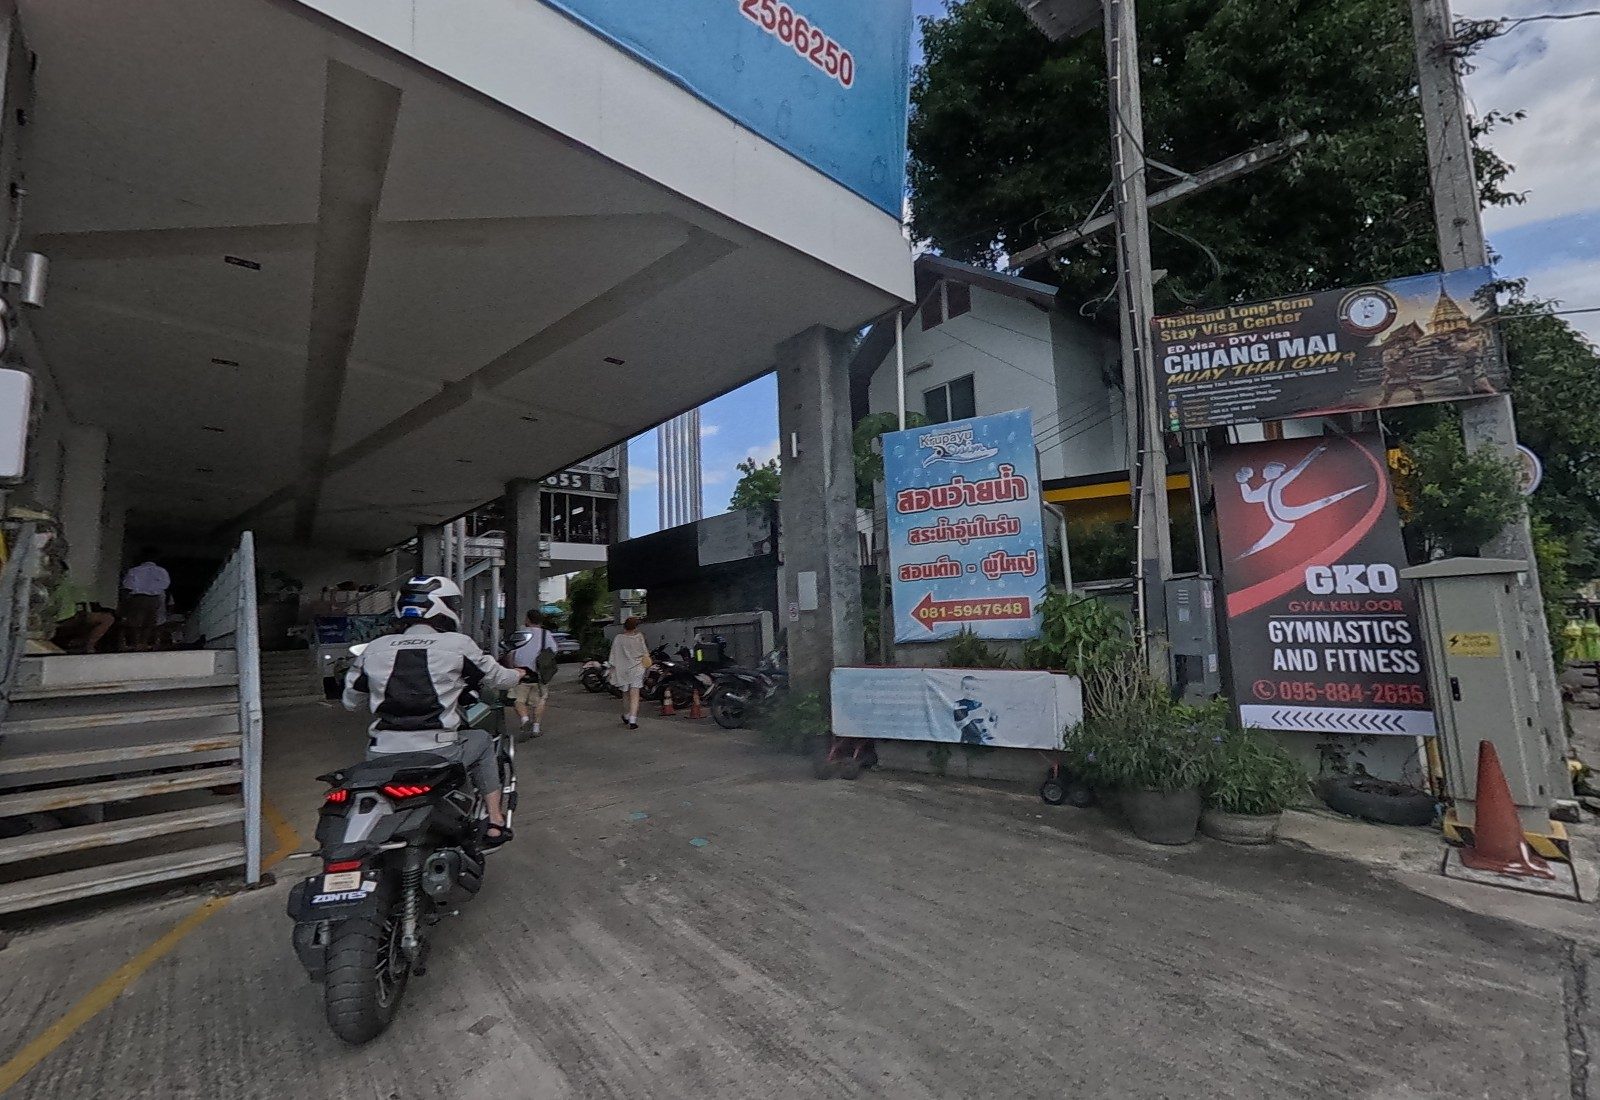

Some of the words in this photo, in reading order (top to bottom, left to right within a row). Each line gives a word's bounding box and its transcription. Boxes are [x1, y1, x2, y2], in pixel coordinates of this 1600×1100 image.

[740, 0, 853, 87] 2586250
[1157, 308, 1225, 329] Thailand
[1229, 298, 1314, 318] Long-Term
[1161, 327, 1197, 342] Stay
[1202, 322, 1238, 335] Visa
[1243, 312, 1302, 329] Center
[1164, 343, 1270, 374] CHIANG
[1278, 333, 1337, 359] MAI
[1167, 345, 1186, 354] ED
[1189, 341, 1216, 351] visa
[1228, 334, 1258, 345] DTV
[1262, 331, 1291, 341] visa
[1167, 367, 1227, 385] MUAY
[1231, 360, 1285, 376] THAI
[1292, 352, 1341, 369] GYM
[920, 430, 973, 448] Krupayu
[898, 465, 1027, 513] สอนว่ายน้ำ
[909, 515, 1019, 544] สระน้ำอุ่นในร่ม
[900, 556, 961, 580] สอนเด็ก
[982, 551, 1036, 579] ผู้ใหญ่
[1305, 563, 1399, 595] GKO
[920, 602, 1023, 619] 081-5947648
[1268, 620, 1413, 645] GYMNASTICS
[1273, 648, 1318, 672] AND
[1324, 649, 1421, 674] FITNESS
[311, 890, 368, 903] ZONTES
